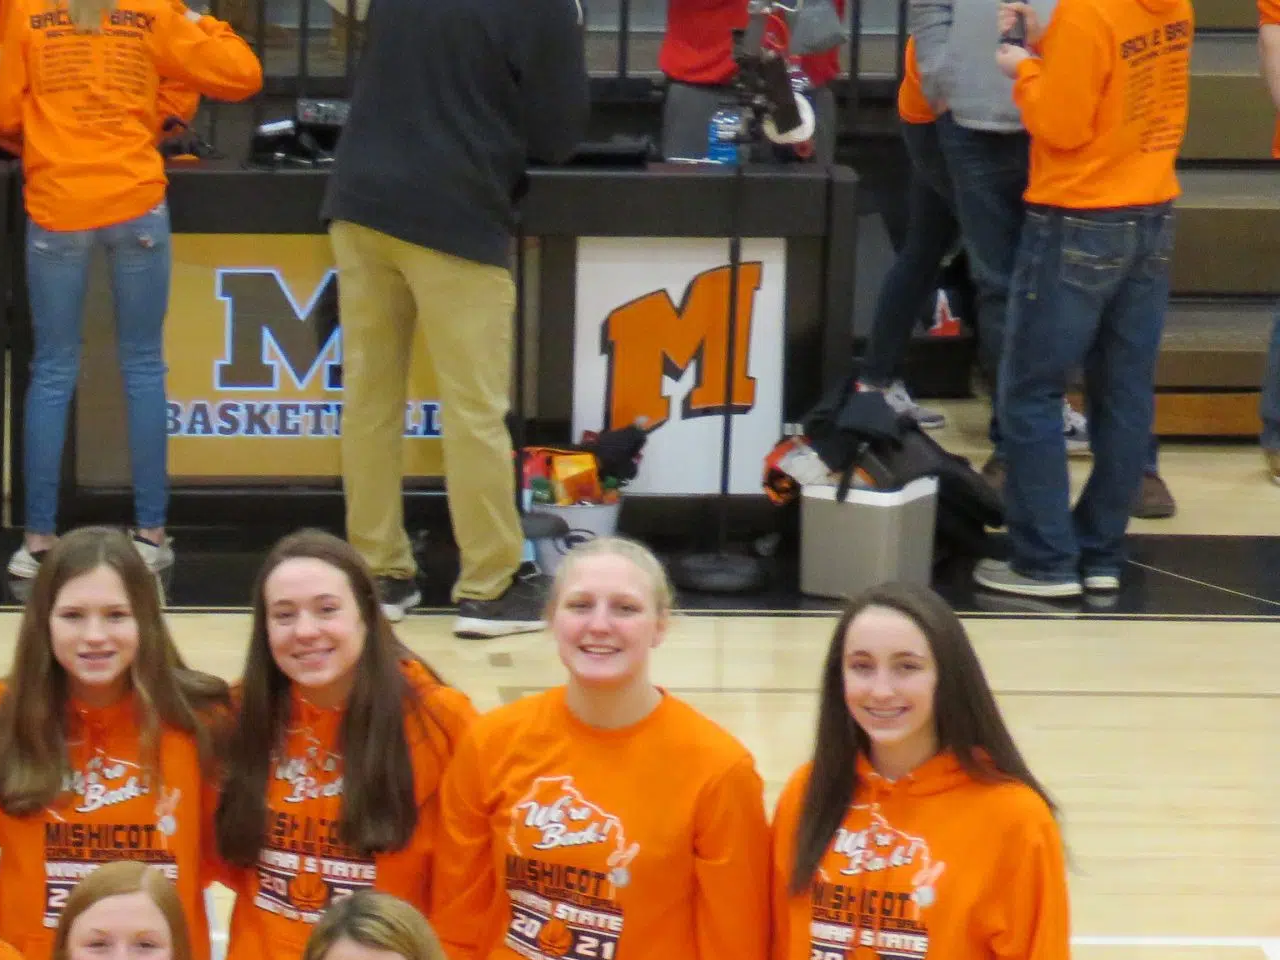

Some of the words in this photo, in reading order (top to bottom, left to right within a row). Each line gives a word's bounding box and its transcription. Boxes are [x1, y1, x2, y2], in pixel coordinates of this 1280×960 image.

[167, 401, 443, 437] BASKETL
[45, 823, 159, 849] MISHICOT
[505, 854, 607, 897] MISHICOT
[553, 902, 624, 932] STATE
[812, 881, 912, 918] MISHICOT
[511, 911, 543, 940] 20
[574, 934, 616, 960] 21
[860, 929, 929, 953] STATE
